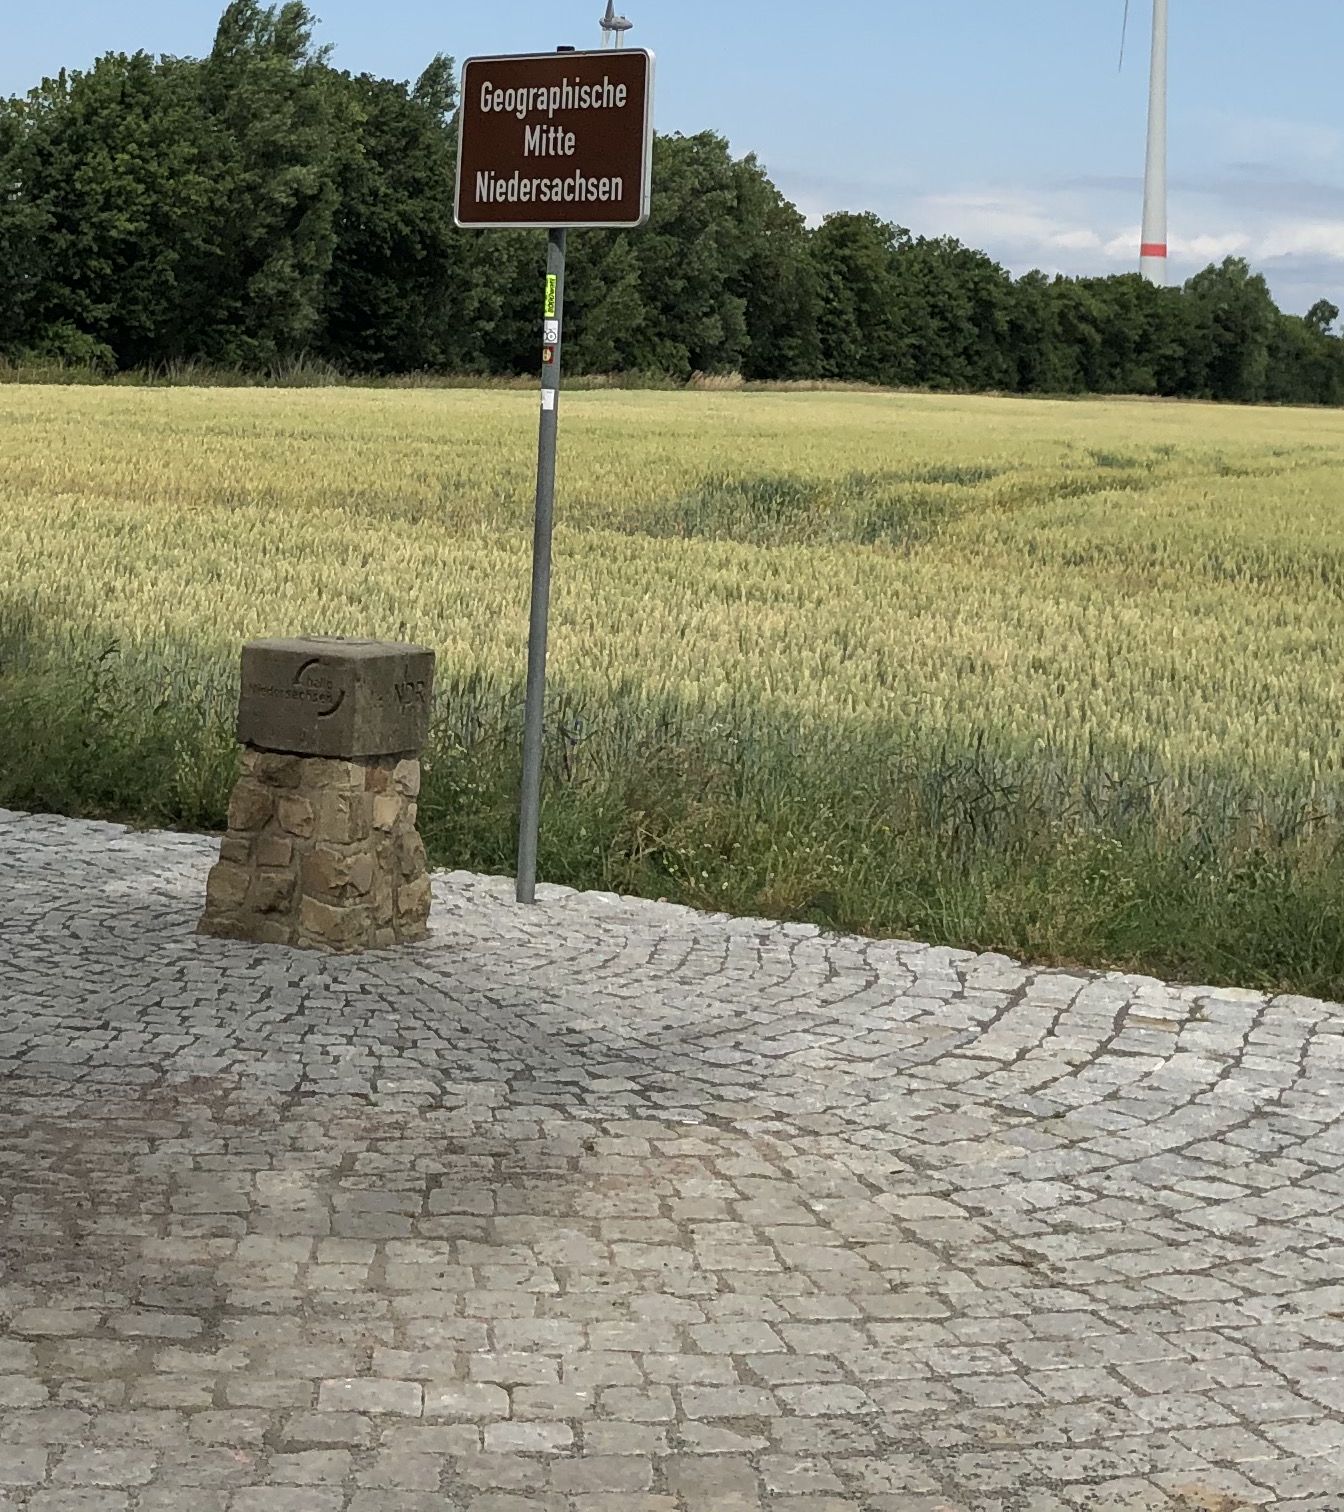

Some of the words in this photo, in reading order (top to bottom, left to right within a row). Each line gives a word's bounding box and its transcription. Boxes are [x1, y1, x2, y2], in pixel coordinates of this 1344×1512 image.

[480, 75, 627, 120] Geographische
[523, 124, 576, 157] Mitte
[475, 168, 623, 203] Niedersachsen
